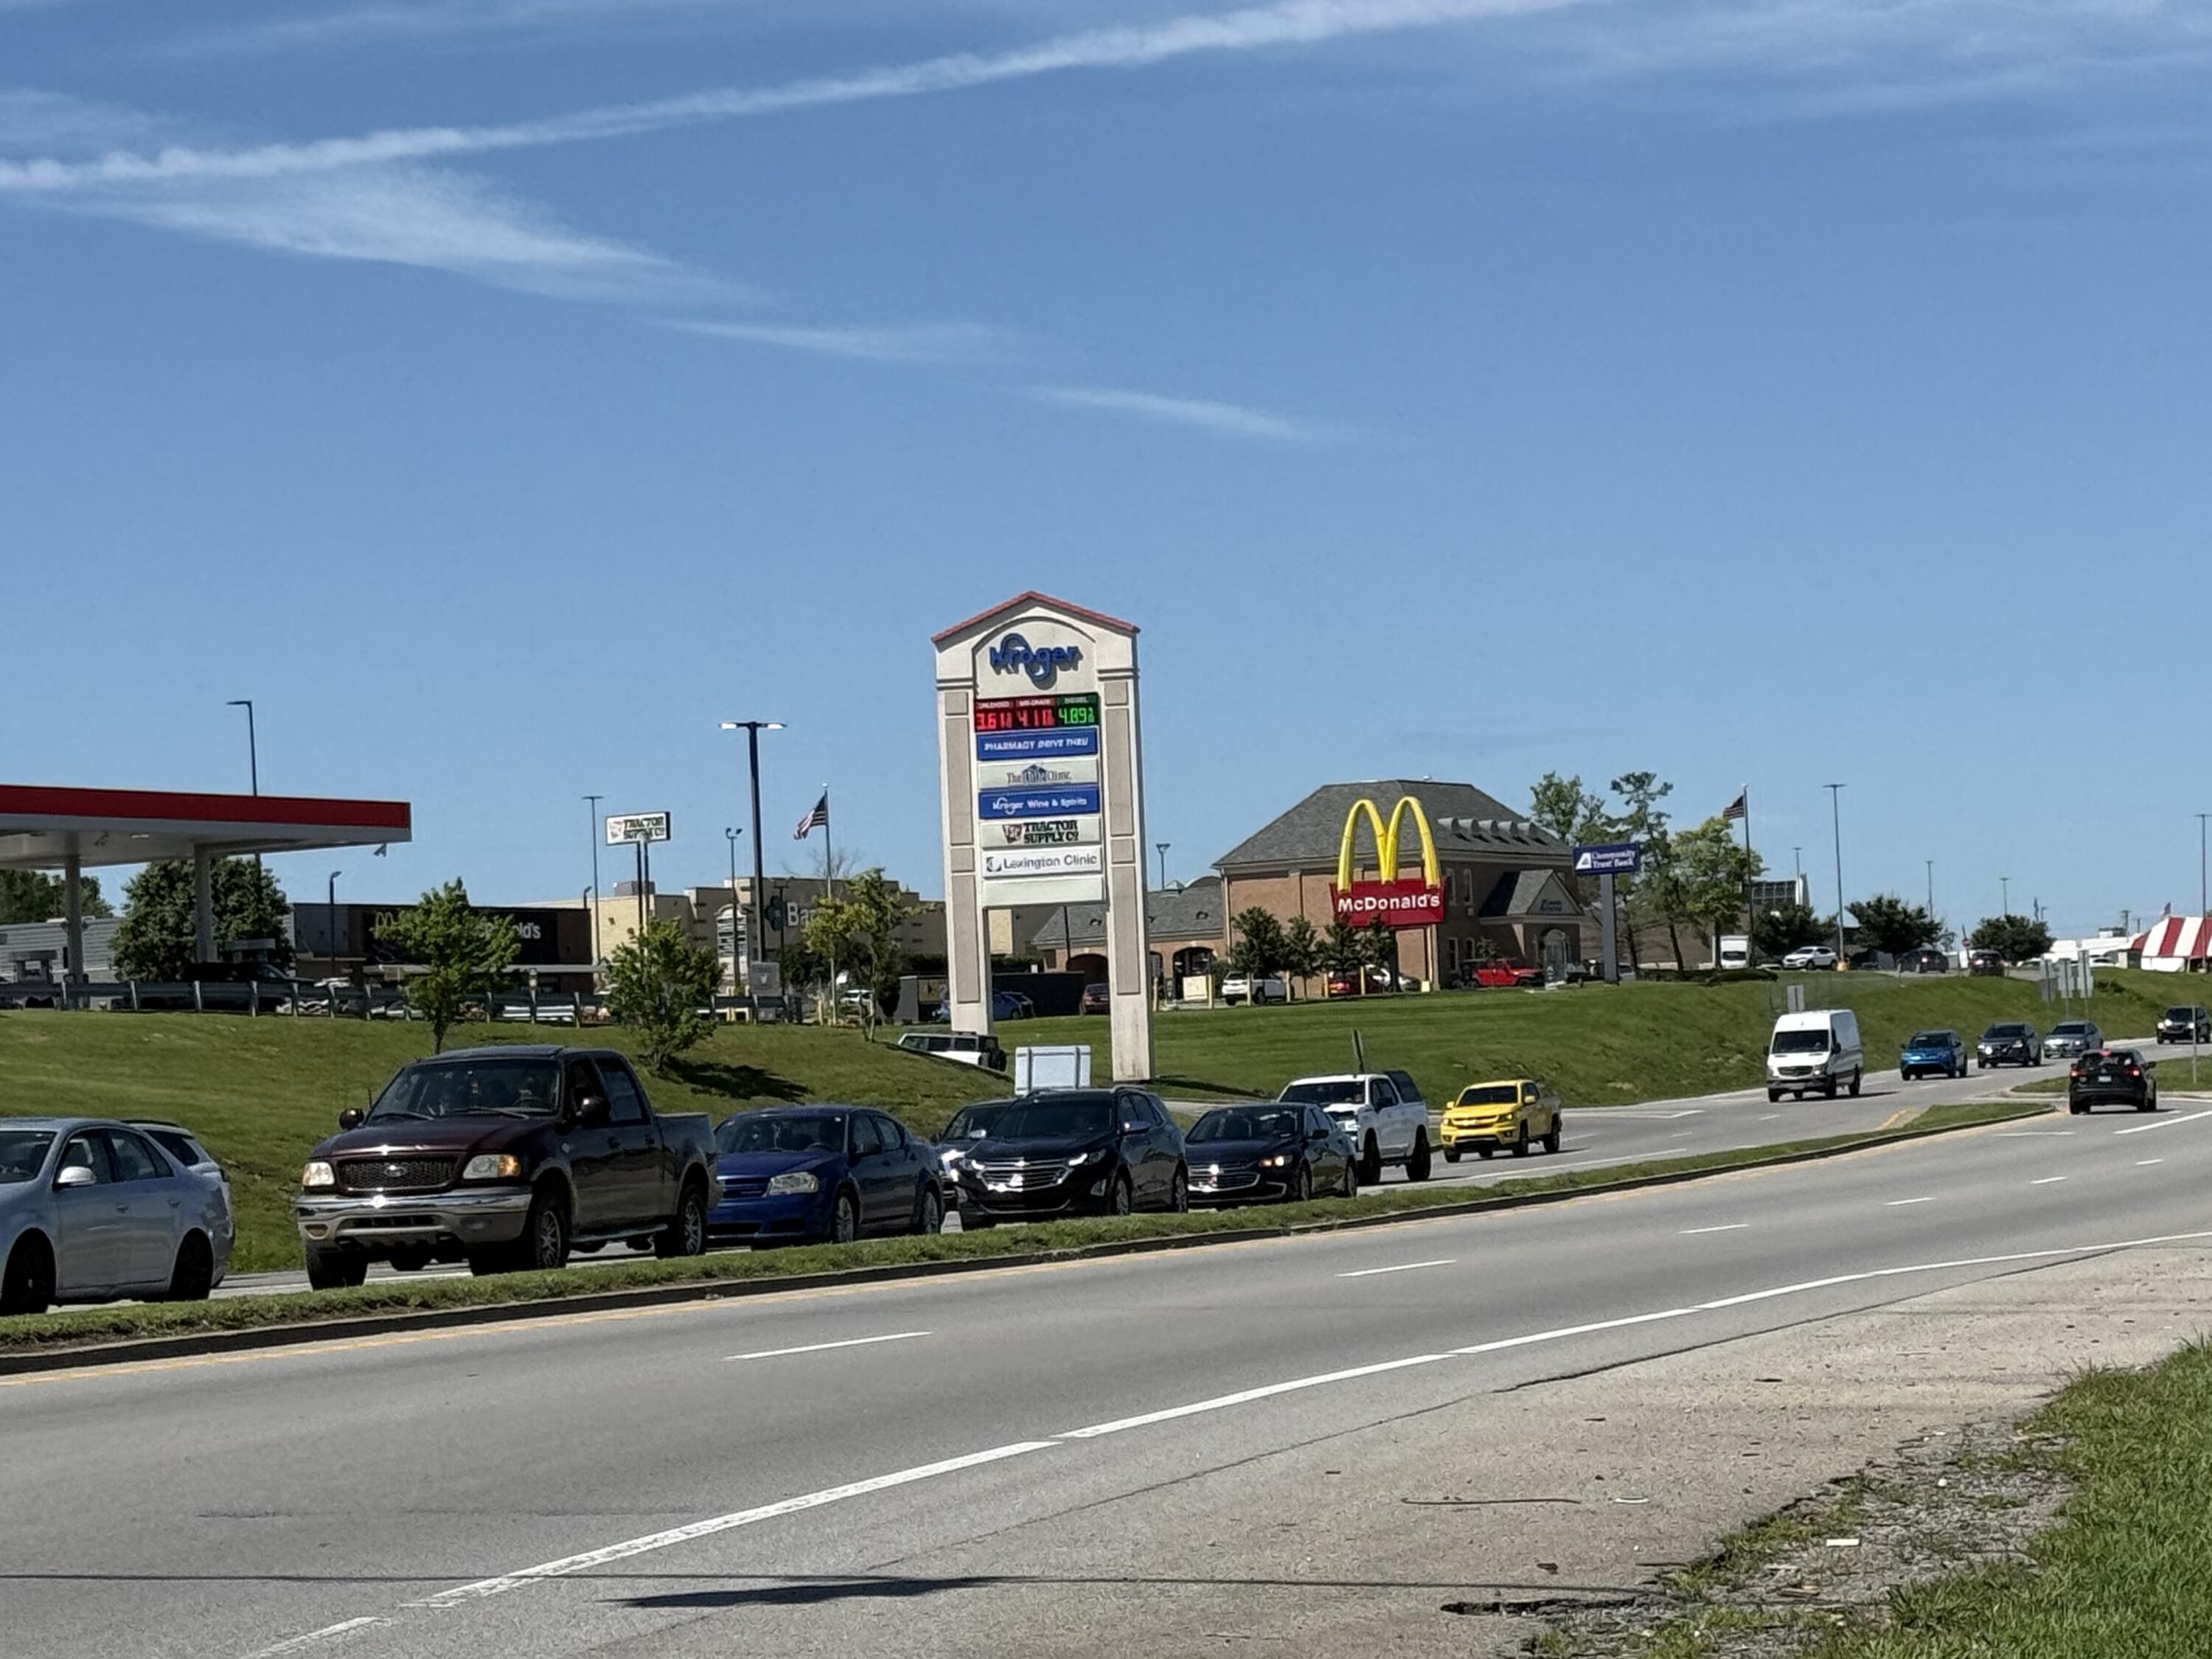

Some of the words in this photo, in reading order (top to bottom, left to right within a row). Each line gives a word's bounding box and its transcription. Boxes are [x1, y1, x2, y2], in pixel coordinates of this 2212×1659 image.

[989, 633, 1079, 681] Kroger
[984, 740, 1035, 751] PHARMACY
[1037, 739, 1064, 749] DRIVE
[1066, 737, 1088, 747] THRU
[992, 797, 1024, 815] Kroger
[1027, 799, 1049, 808] Wine
[623, 816, 664, 829] TRACTOR
[1023, 820, 1079, 832] TRACTOR
[1024, 832, 1065, 844] SUPPLY
[1004, 857, 1060, 870] Lexington
[1064, 853, 1098, 866] Clinic
[1338, 894, 1441, 913] McDonald's
